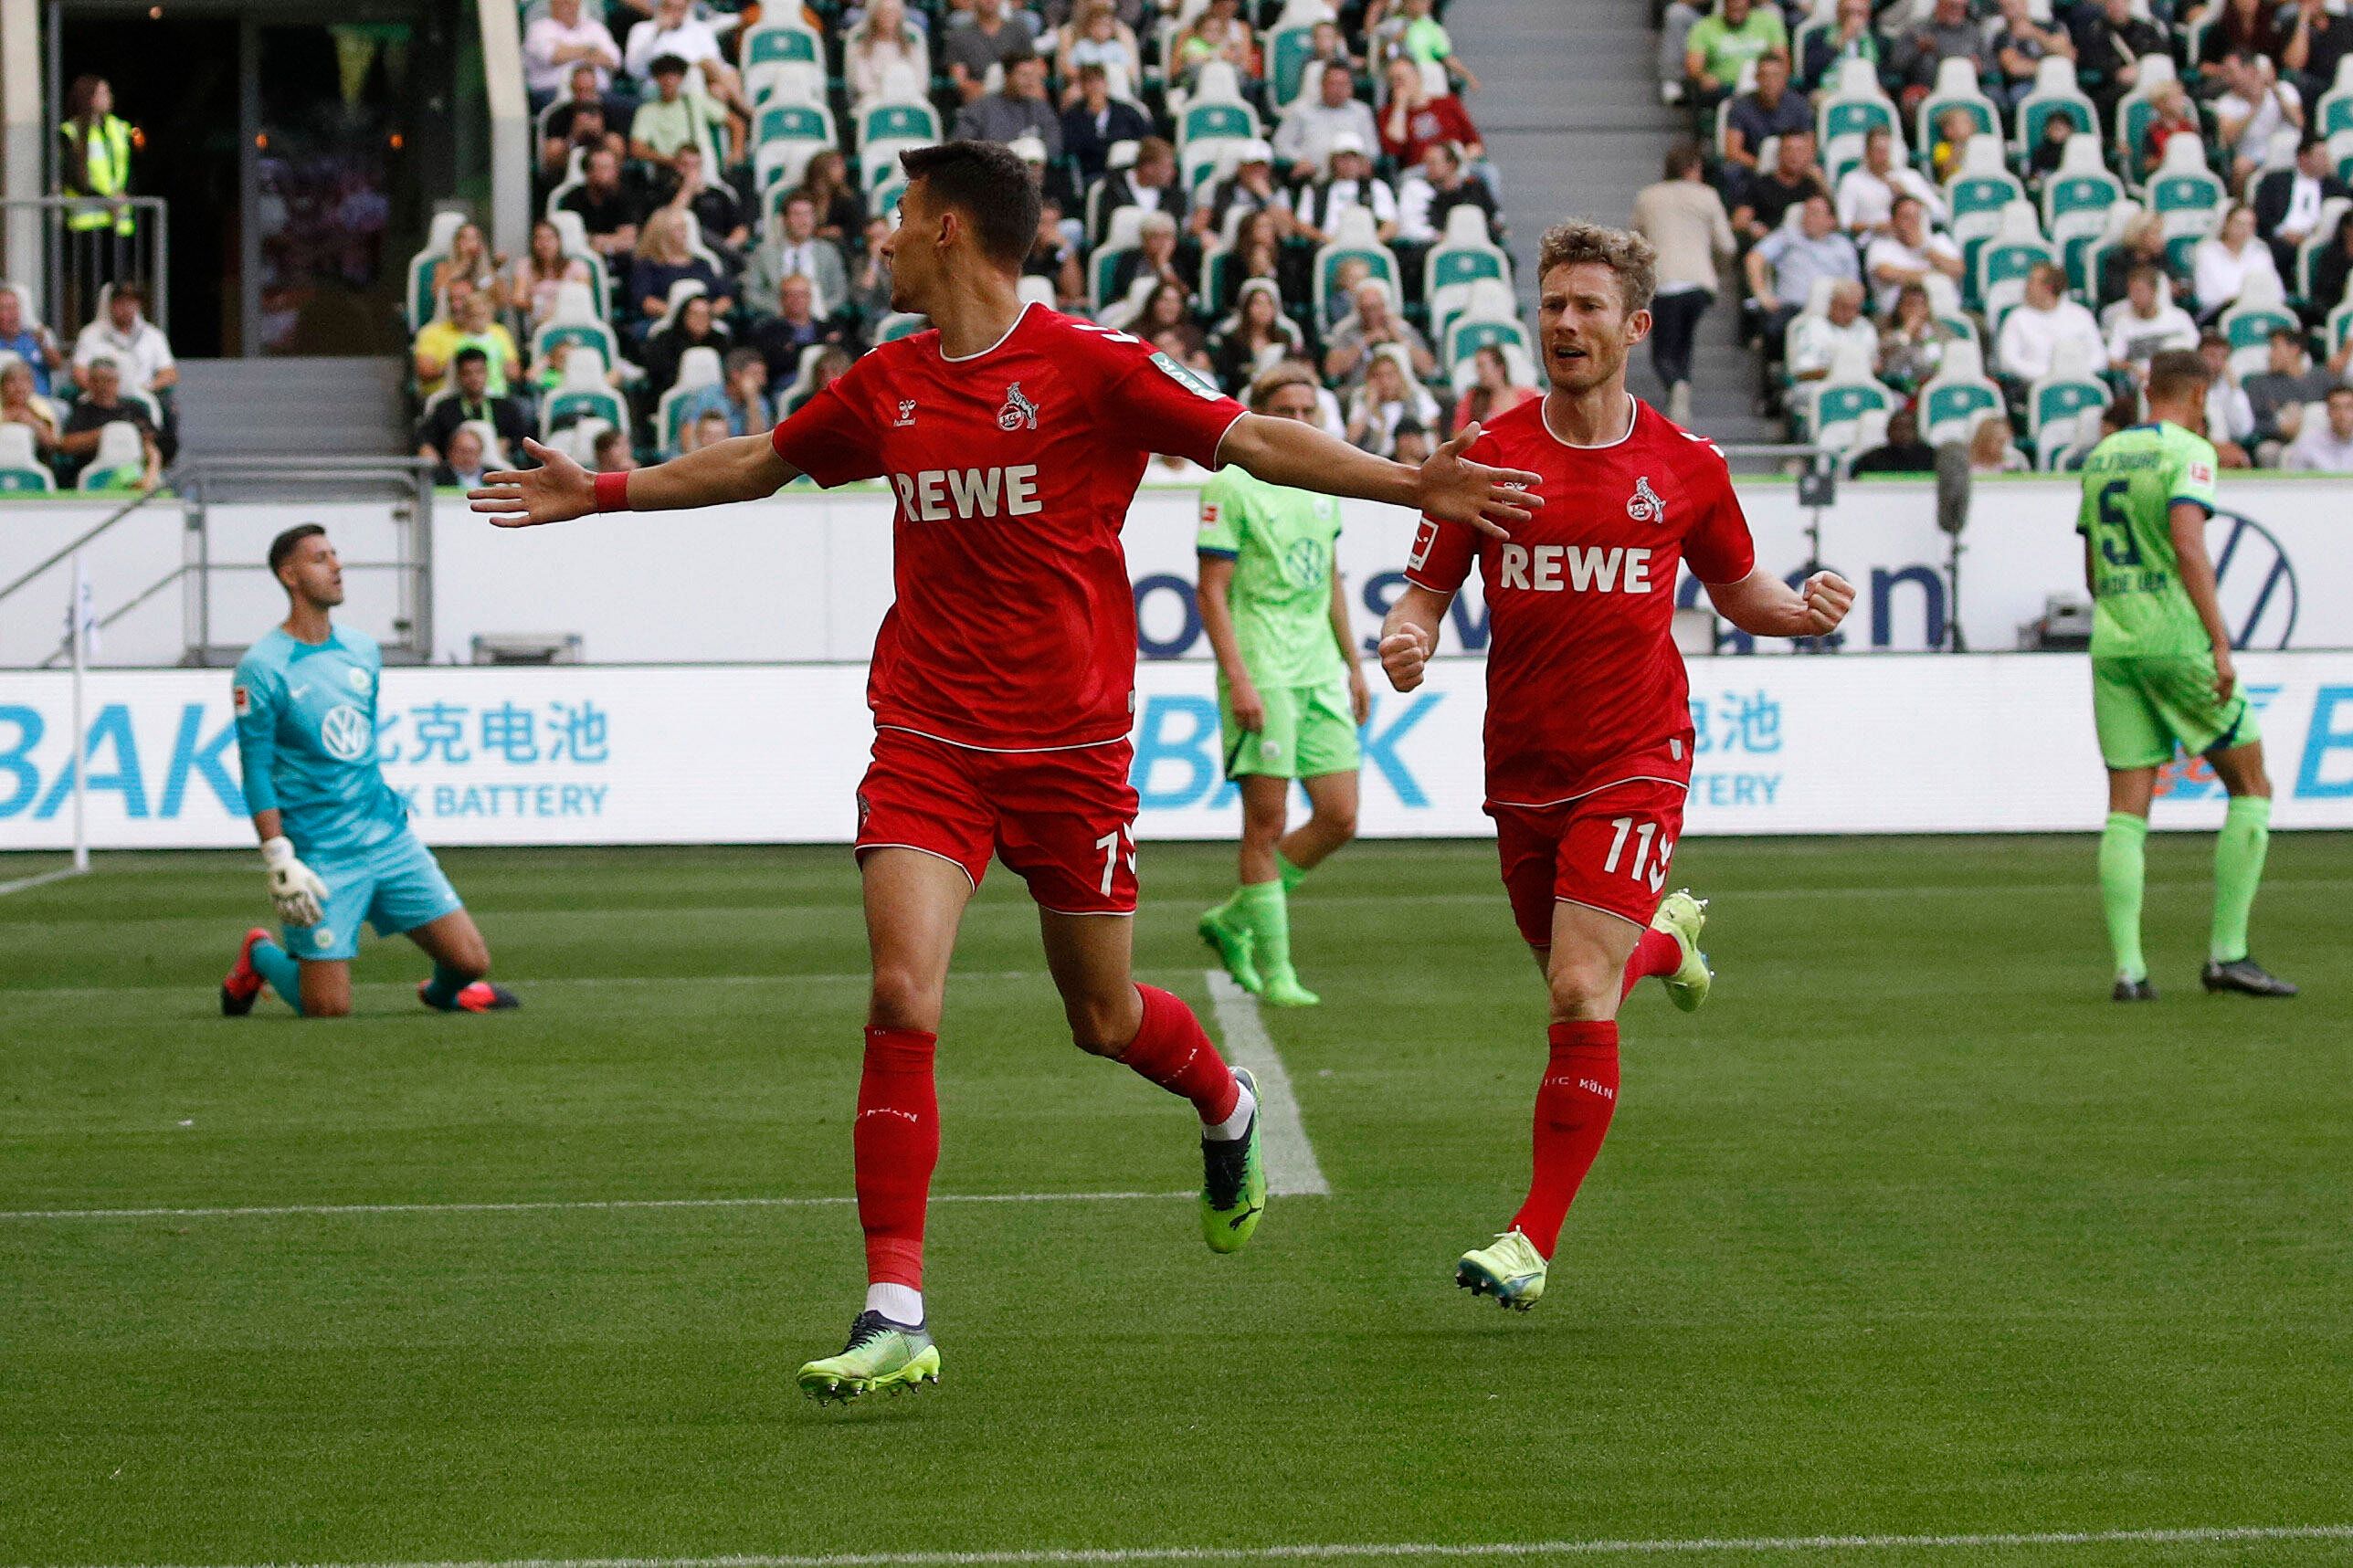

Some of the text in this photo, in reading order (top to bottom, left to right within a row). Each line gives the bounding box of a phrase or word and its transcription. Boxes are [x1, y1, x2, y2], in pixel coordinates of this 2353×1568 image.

[894, 464, 1043, 522] REWE
[2099, 479, 2142, 565] 5
[1500, 542, 1652, 595] REWE
[1129, 692, 1450, 811] BK
[433, 784, 610, 817] BATTERY
[1095, 830, 1119, 898] 7
[1604, 816, 1657, 881] 11
[1578, 1078, 1614, 1100] KÖLN
